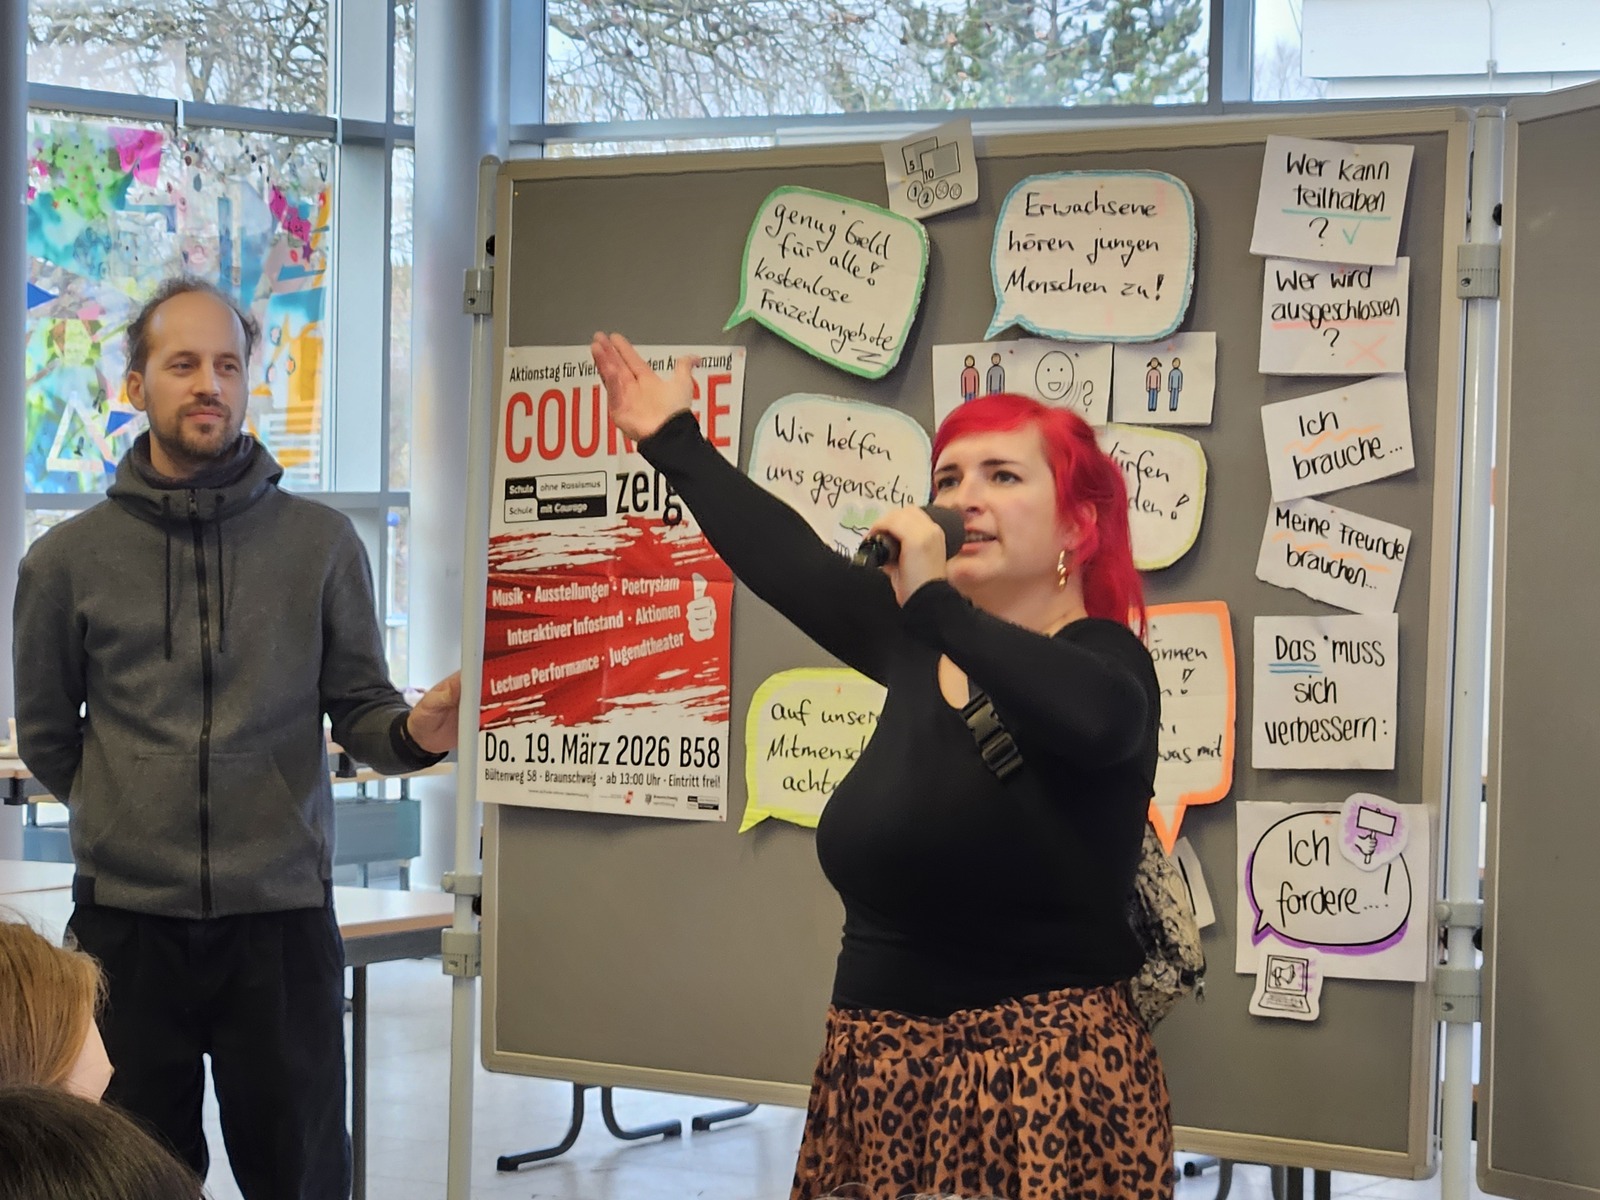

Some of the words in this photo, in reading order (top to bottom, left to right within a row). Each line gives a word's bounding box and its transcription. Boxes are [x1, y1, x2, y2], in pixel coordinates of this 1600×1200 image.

[909, 160, 916, 171] 5
[924, 168, 935, 180] 10
[1287, 152, 1330, 177] Wer
[1338, 159, 1389, 181] kann
[1025, 189, 1158, 218] Erwachsene
[1293, 184, 1386, 212] teilhaben
[764, 204, 837, 253] genug
[845, 220, 891, 260] Geld
[777, 231, 815, 259] für
[1308, 216, 1330, 247] ?
[1009, 230, 1075, 252] hören
[1087, 236, 1160, 268] jungen
[1004, 265, 1108, 294] Menschen
[1275, 270, 1320, 292] Wer
[1329, 267, 1374, 290] wird
[760, 288, 895, 354] Freizeitangebote
[1271, 297, 1401, 330] ausgeschlossen
[1322, 328, 1340, 357] ?
[510, 362, 561, 383] Aktionstag
[562, 362, 577, 378] für
[578, 360, 600, 377] Viel
[504, 373, 732, 464] COUE
[1298, 411, 1340, 438] Ich
[774, 414, 815, 445] Wir
[826, 423, 892, 461] helfen
[540, 483, 558, 492] ohne
[560, 481, 601, 491] Rassismus
[766, 464, 804, 485] uns
[509, 507, 533, 516] Schule
[615, 470, 684, 526] zeig
[1275, 507, 1331, 538] Meine
[1339, 521, 1405, 562] Freunde
[492, 589, 524, 607] Musik
[534, 582, 610, 603] Ausstellungen
[621, 576, 680, 597] Poetryslam
[507, 620, 572, 646] Interaktiver
[573, 610, 624, 635] Infostand
[635, 603, 681, 625] Aktionen
[490, 671, 531, 696] Lecture
[531, 653, 600, 686] Performance
[608, 631, 685, 668] Jugendtheater
[1150, 638, 1208, 662] önnen
[1275, 635, 1317, 662] Das
[1331, 639, 1386, 667] muss
[1293, 674, 1338, 705] sich
[771, 698, 812, 727] auf
[1264, 715, 1388, 746] verbessern:
[485, 732, 516, 763] Do.
[525, 732, 556, 764] 19.
[561, 732, 610, 765] März
[615, 735, 671, 768] 2026
[679, 736, 721, 769] B58
[1197, 734, 1223, 758] mit
[484, 768, 525, 785] Bültenweg
[526, 770, 538, 783] 58
[544, 769, 597, 787] Braunschweig
[606, 772, 617, 786] ab
[619, 772, 644, 786] 13:00
[645, 772, 661, 787] Uhr
[668, 773, 701, 789] Eintritt
[1288, 829, 1330, 867] Ich
